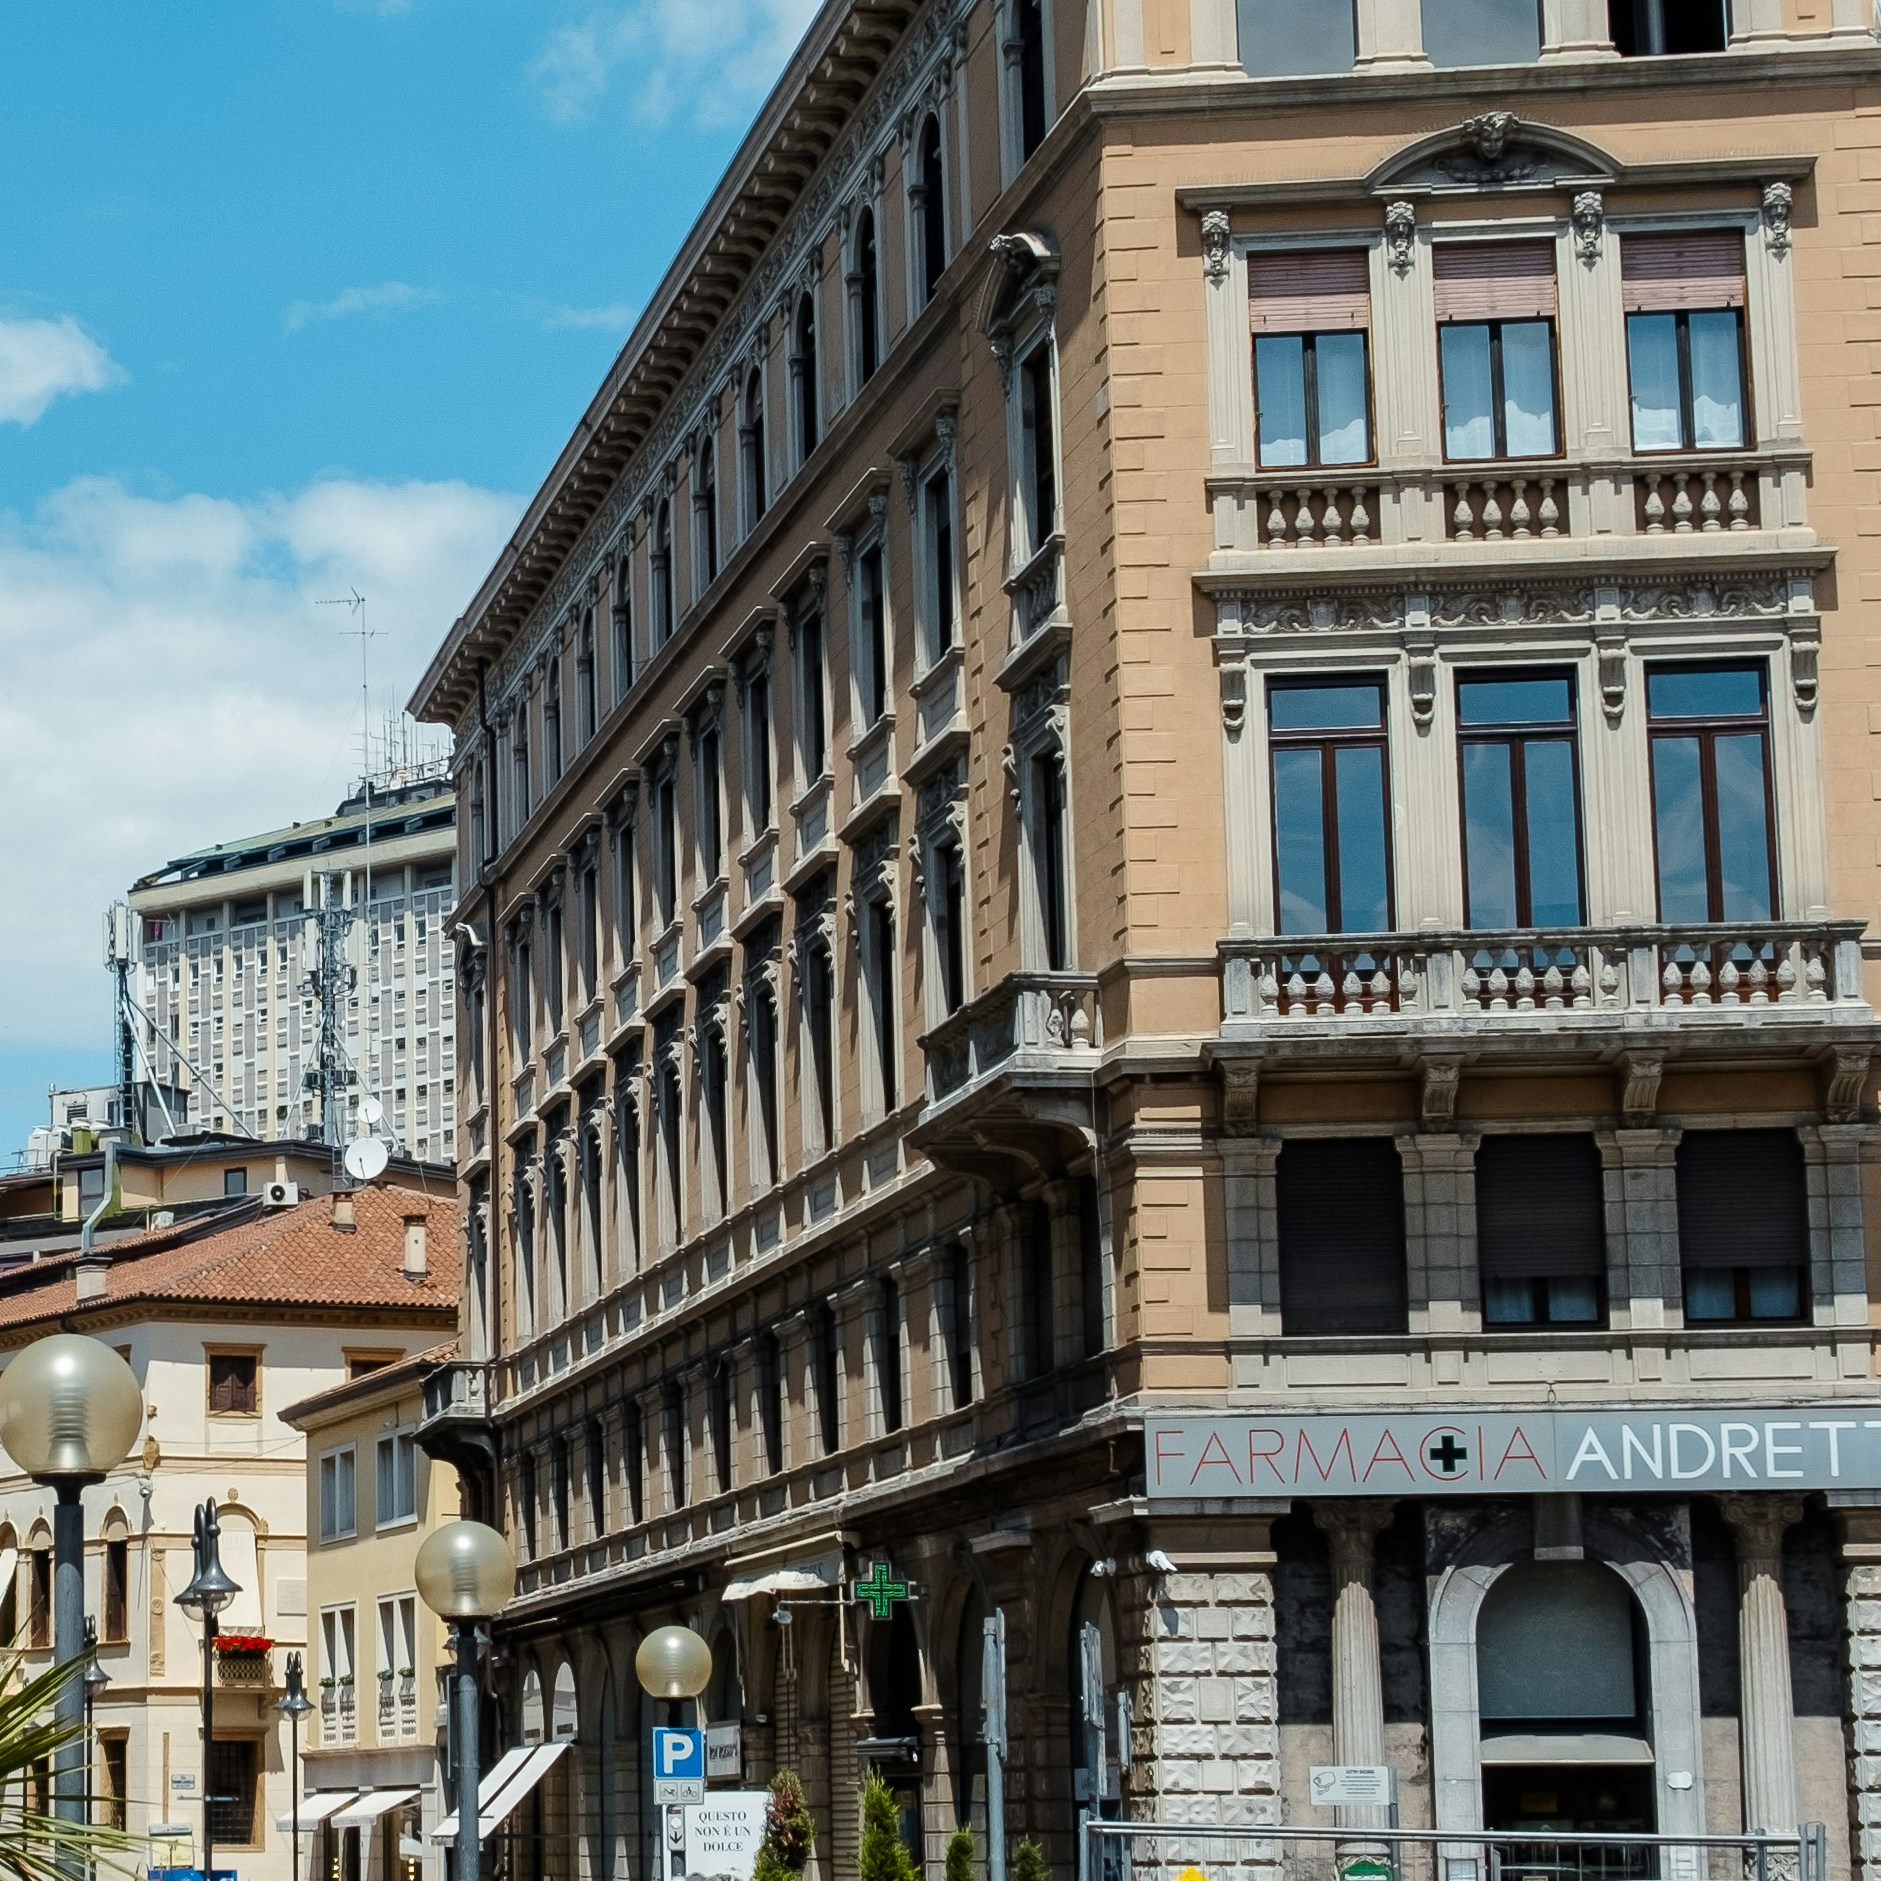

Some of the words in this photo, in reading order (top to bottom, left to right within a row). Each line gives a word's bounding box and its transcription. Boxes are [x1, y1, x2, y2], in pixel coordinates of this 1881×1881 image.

[1154, 1426, 1547, 1487] FARMACIA
[663, 1733, 694, 1774] P
[698, 1811, 747, 1822] QUESTO
[694, 1826, 720, 1837] NON
[724, 1824, 733, 1837] È
[735, 1826, 752, 1837] UN
[703, 1841, 744, 1852] DOLCE
